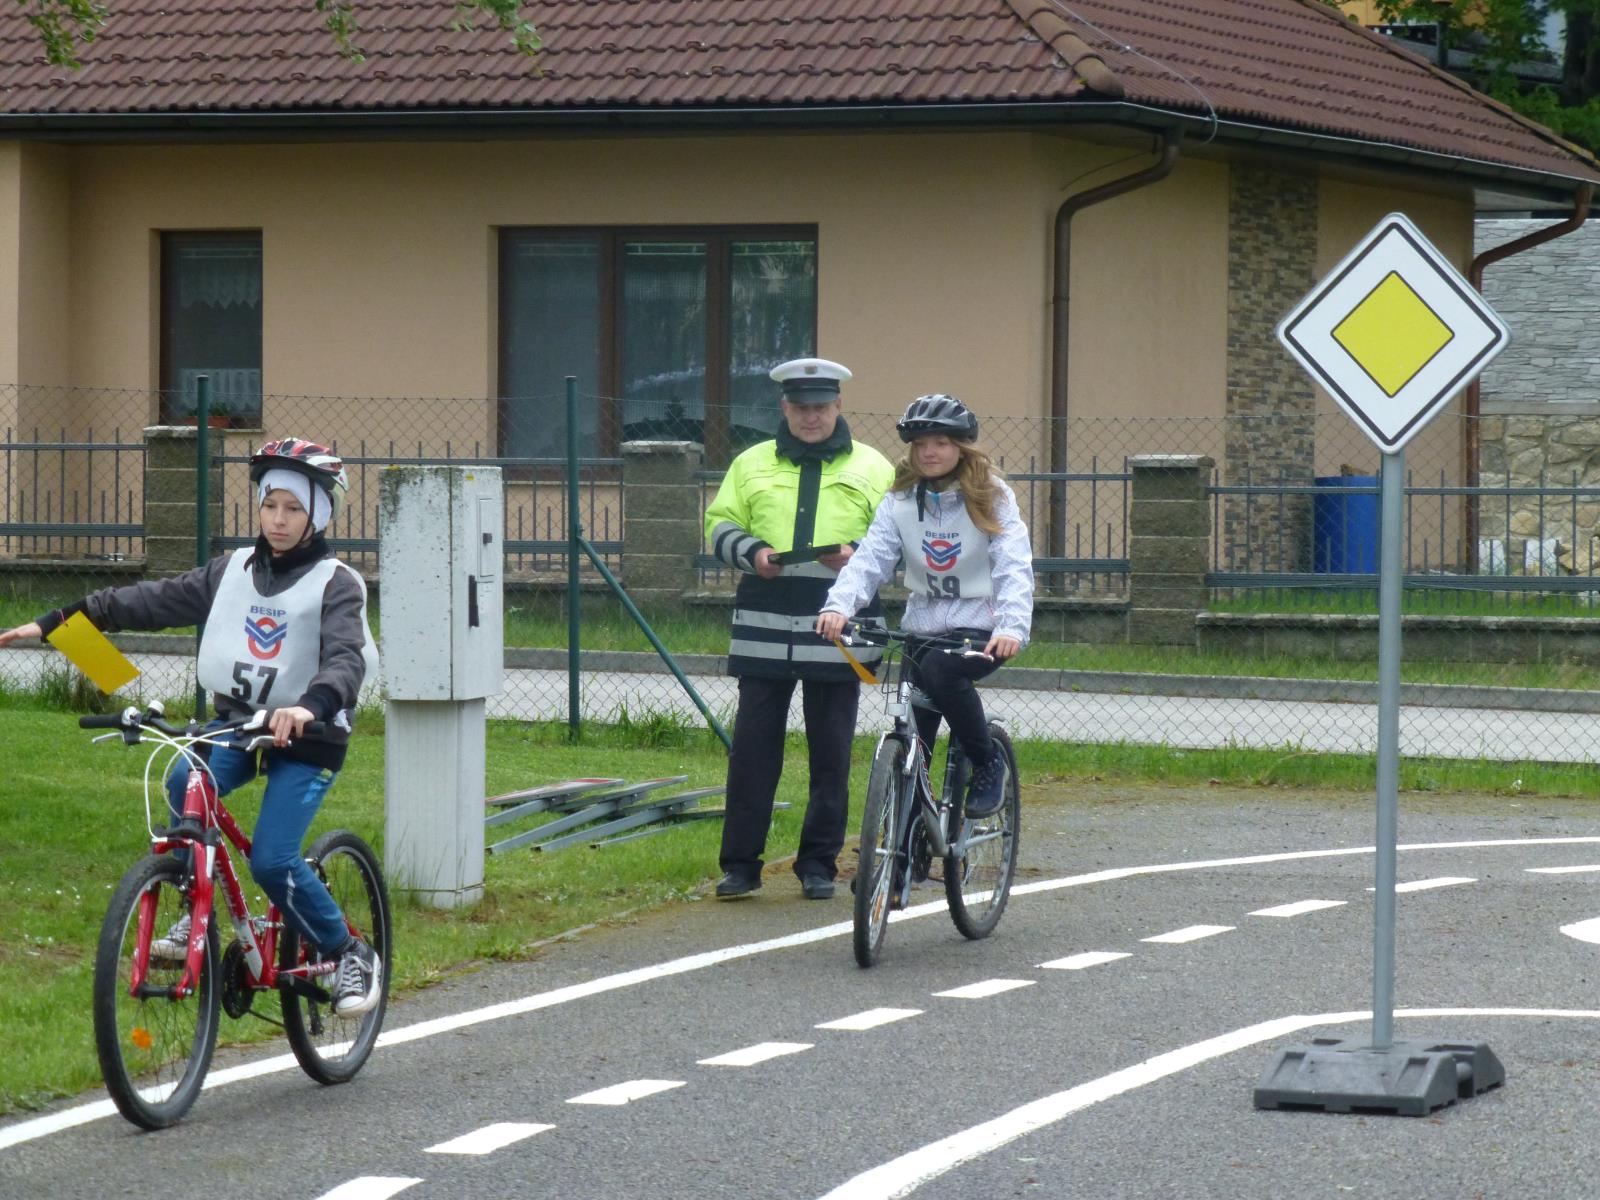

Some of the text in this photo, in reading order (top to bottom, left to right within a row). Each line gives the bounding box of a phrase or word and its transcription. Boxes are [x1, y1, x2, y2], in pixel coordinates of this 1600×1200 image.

[925, 531, 960, 539] BESIP
[926, 573, 960, 599] 59
[250, 605, 286, 617] BESIP
[231, 661, 279, 705] 57
